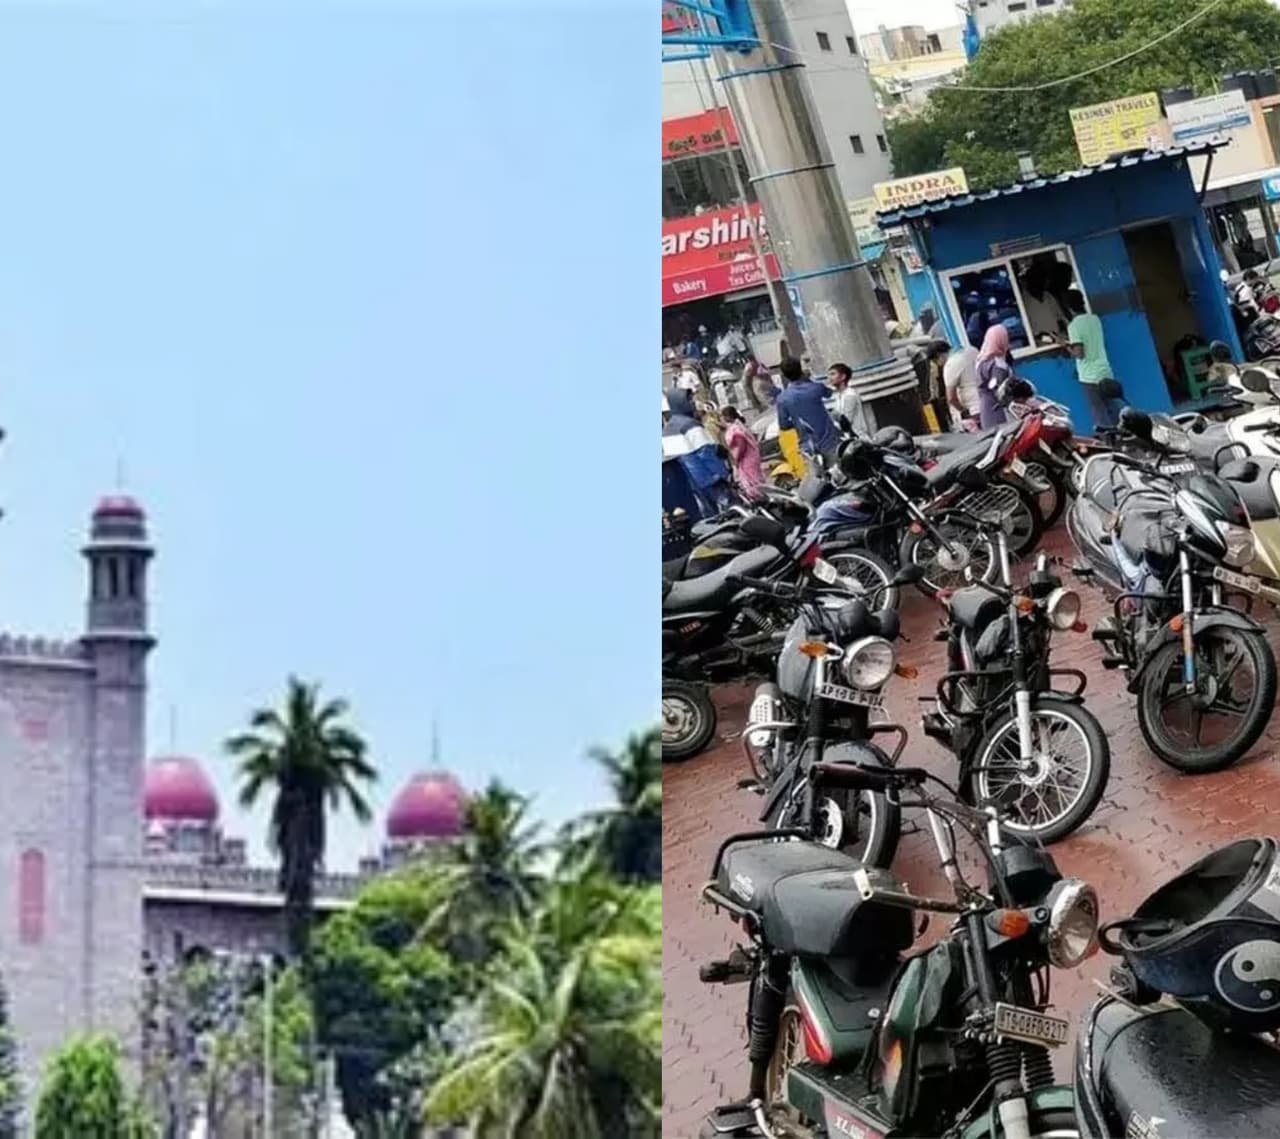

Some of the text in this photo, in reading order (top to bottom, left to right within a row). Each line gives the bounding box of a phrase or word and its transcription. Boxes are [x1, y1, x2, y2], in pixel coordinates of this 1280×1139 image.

[1116, 98, 1156, 114] TRAVELS
[886, 175, 956, 197] INDRA
[672, 269, 763, 295] Bakery Tea Coff
